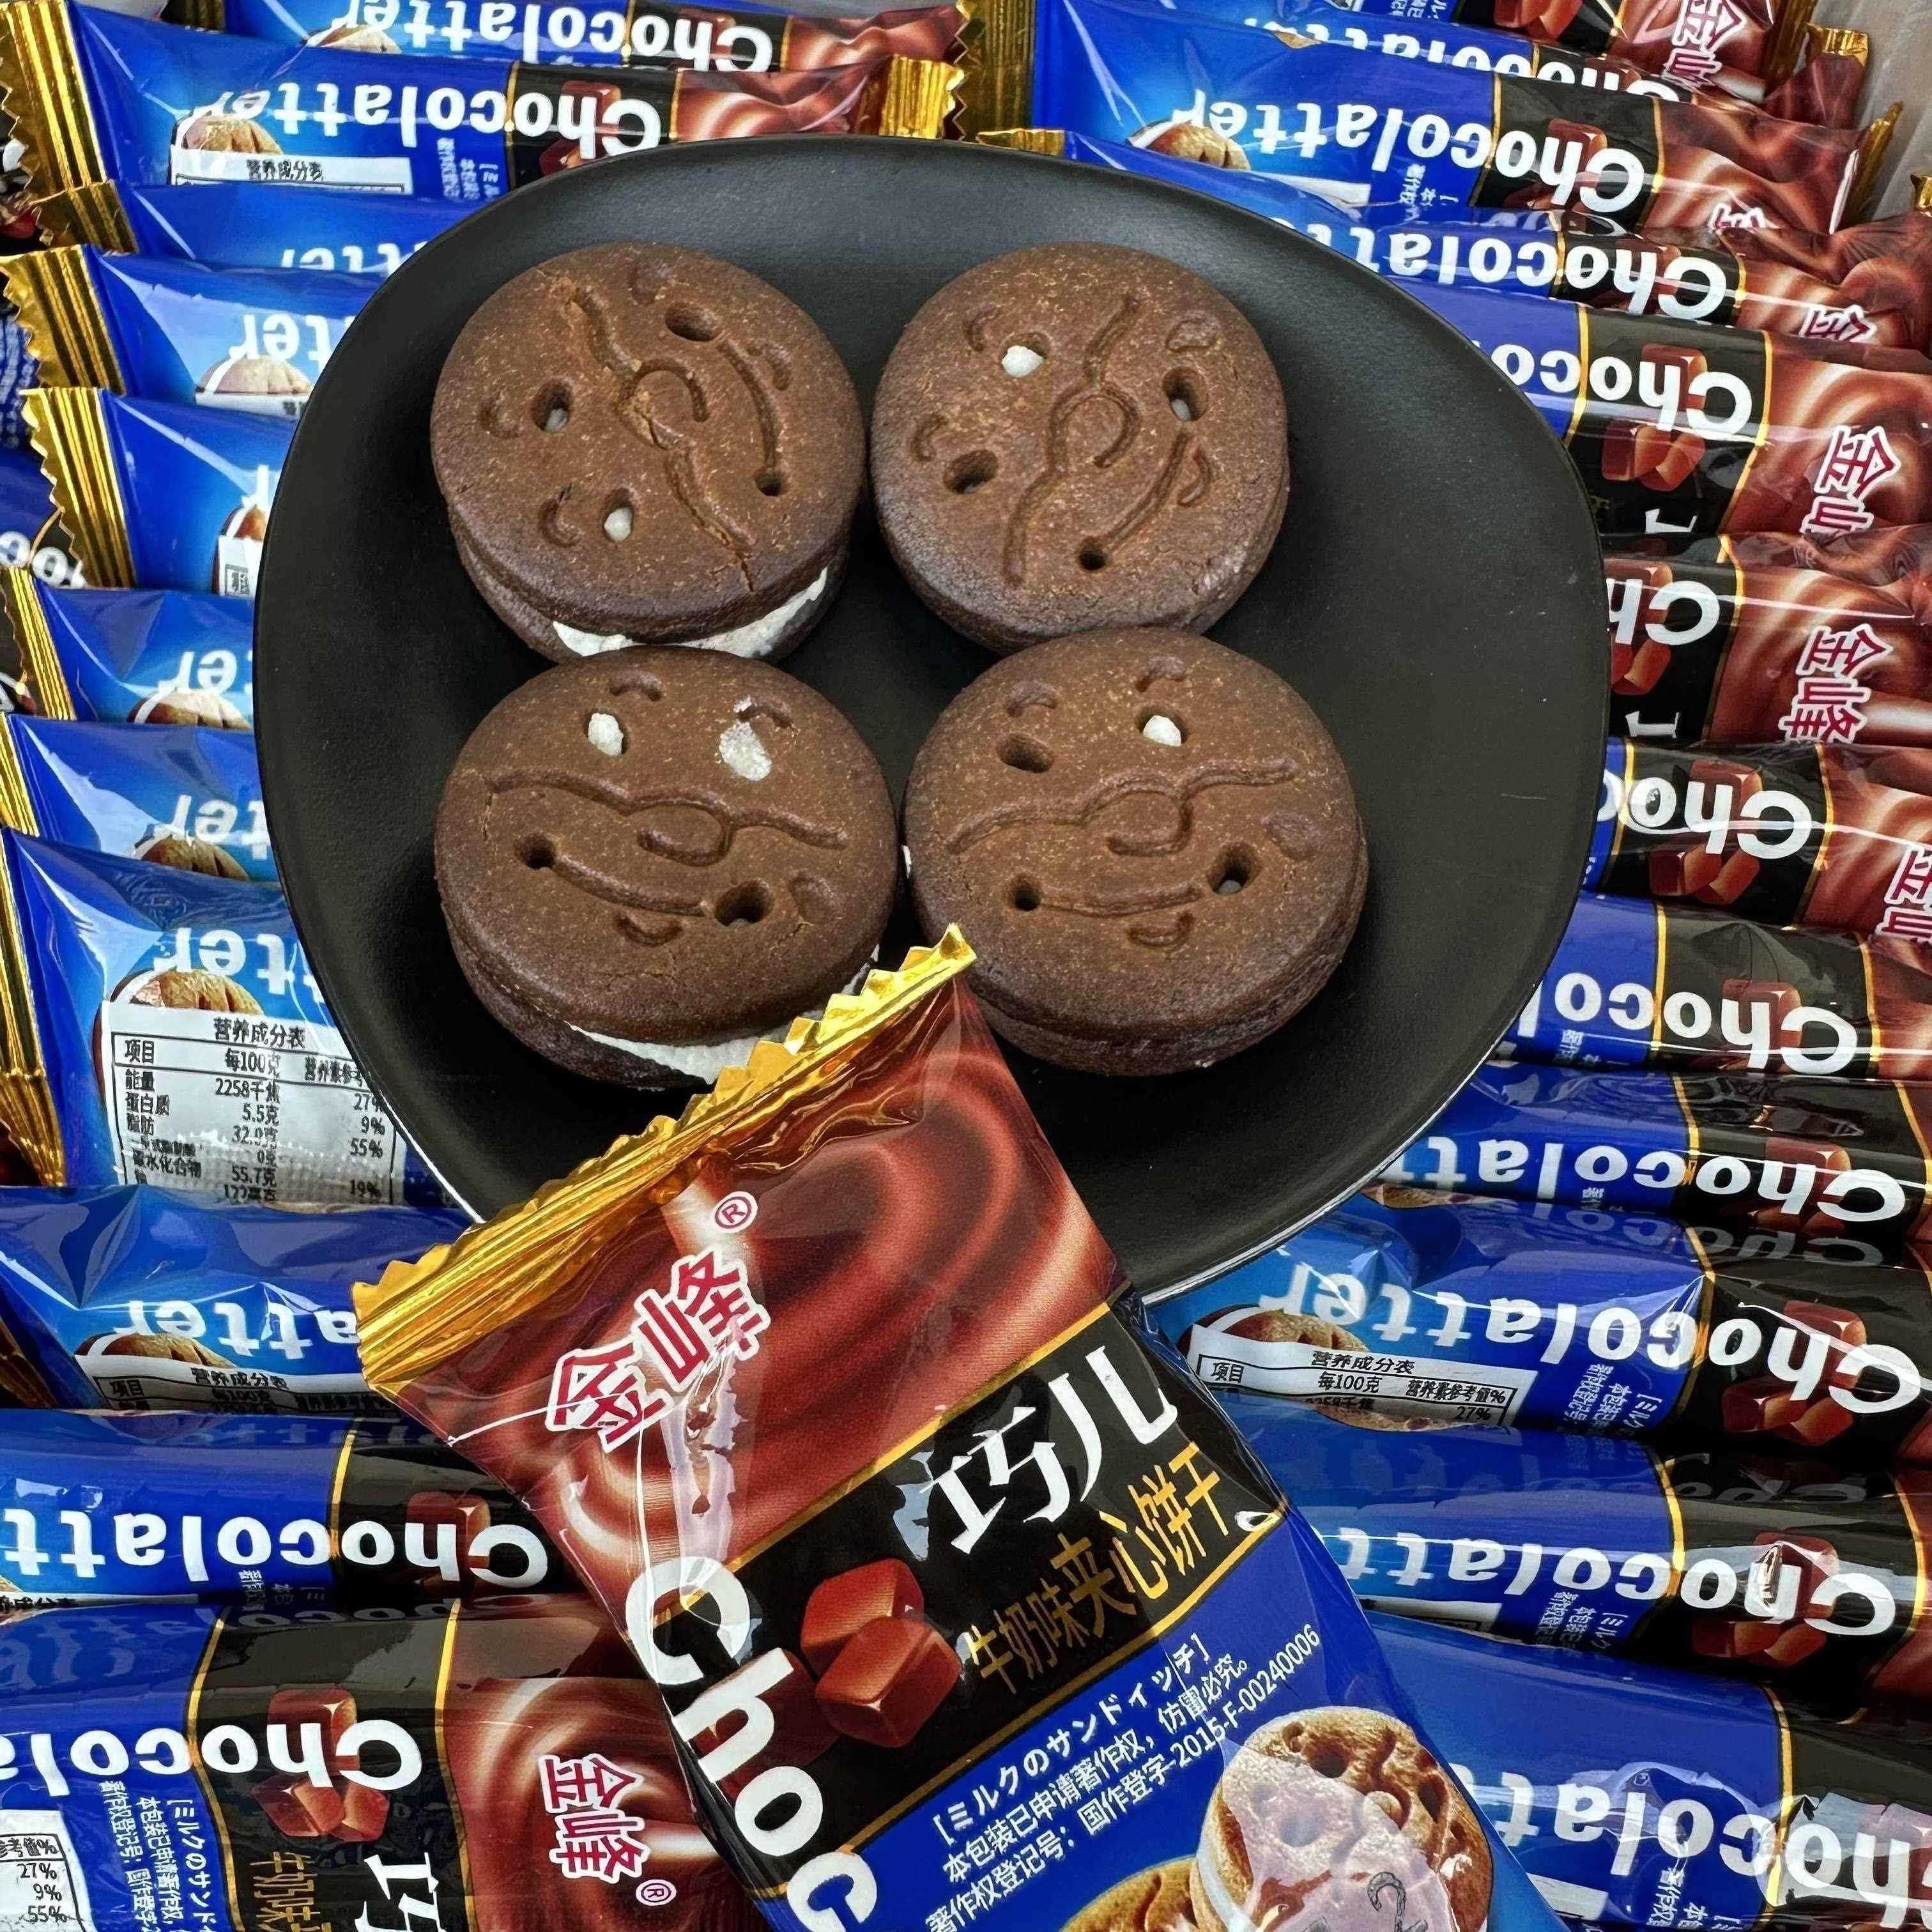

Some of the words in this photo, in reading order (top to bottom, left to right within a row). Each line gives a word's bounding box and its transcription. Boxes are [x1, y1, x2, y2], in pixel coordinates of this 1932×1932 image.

[193, 82, 661, 160] Chocolatter
[1172, 89, 1644, 213] Chocolatter
[1271, 216, 1728, 321] Chocolat
[1779, 623, 1894, 745] 金峰
[350, 1137, 384, 1159] 55%
[361, 1115, 385, 1135] 9%
[544, 1246, 771, 1453] 金峰
[1211, 1361, 1245, 1384] 项目
[1317, 1370, 1383, 1394] 每100克
[1258, 1262, 1920, 1414] Chocolatter
[1310, 1349, 1417, 1376] 营养成分表
[919, 1345, 1178, 1554] 巧儿
[3, 1508, 548, 1588] Chocolatt
[966, 1441, 1230, 1695] 牛奶味夹心饼干
[17, 1862, 58, 1880] 27%
[135, 1796, 184, 1932] 本包装已申请著作权，
[539, 1753, 650, 1884] 金峰
[1448, 1761, 1932, 1929] hocolat
[27, 1904, 68, 1923] 55%
[33, 1882, 63, 1902] 9%
